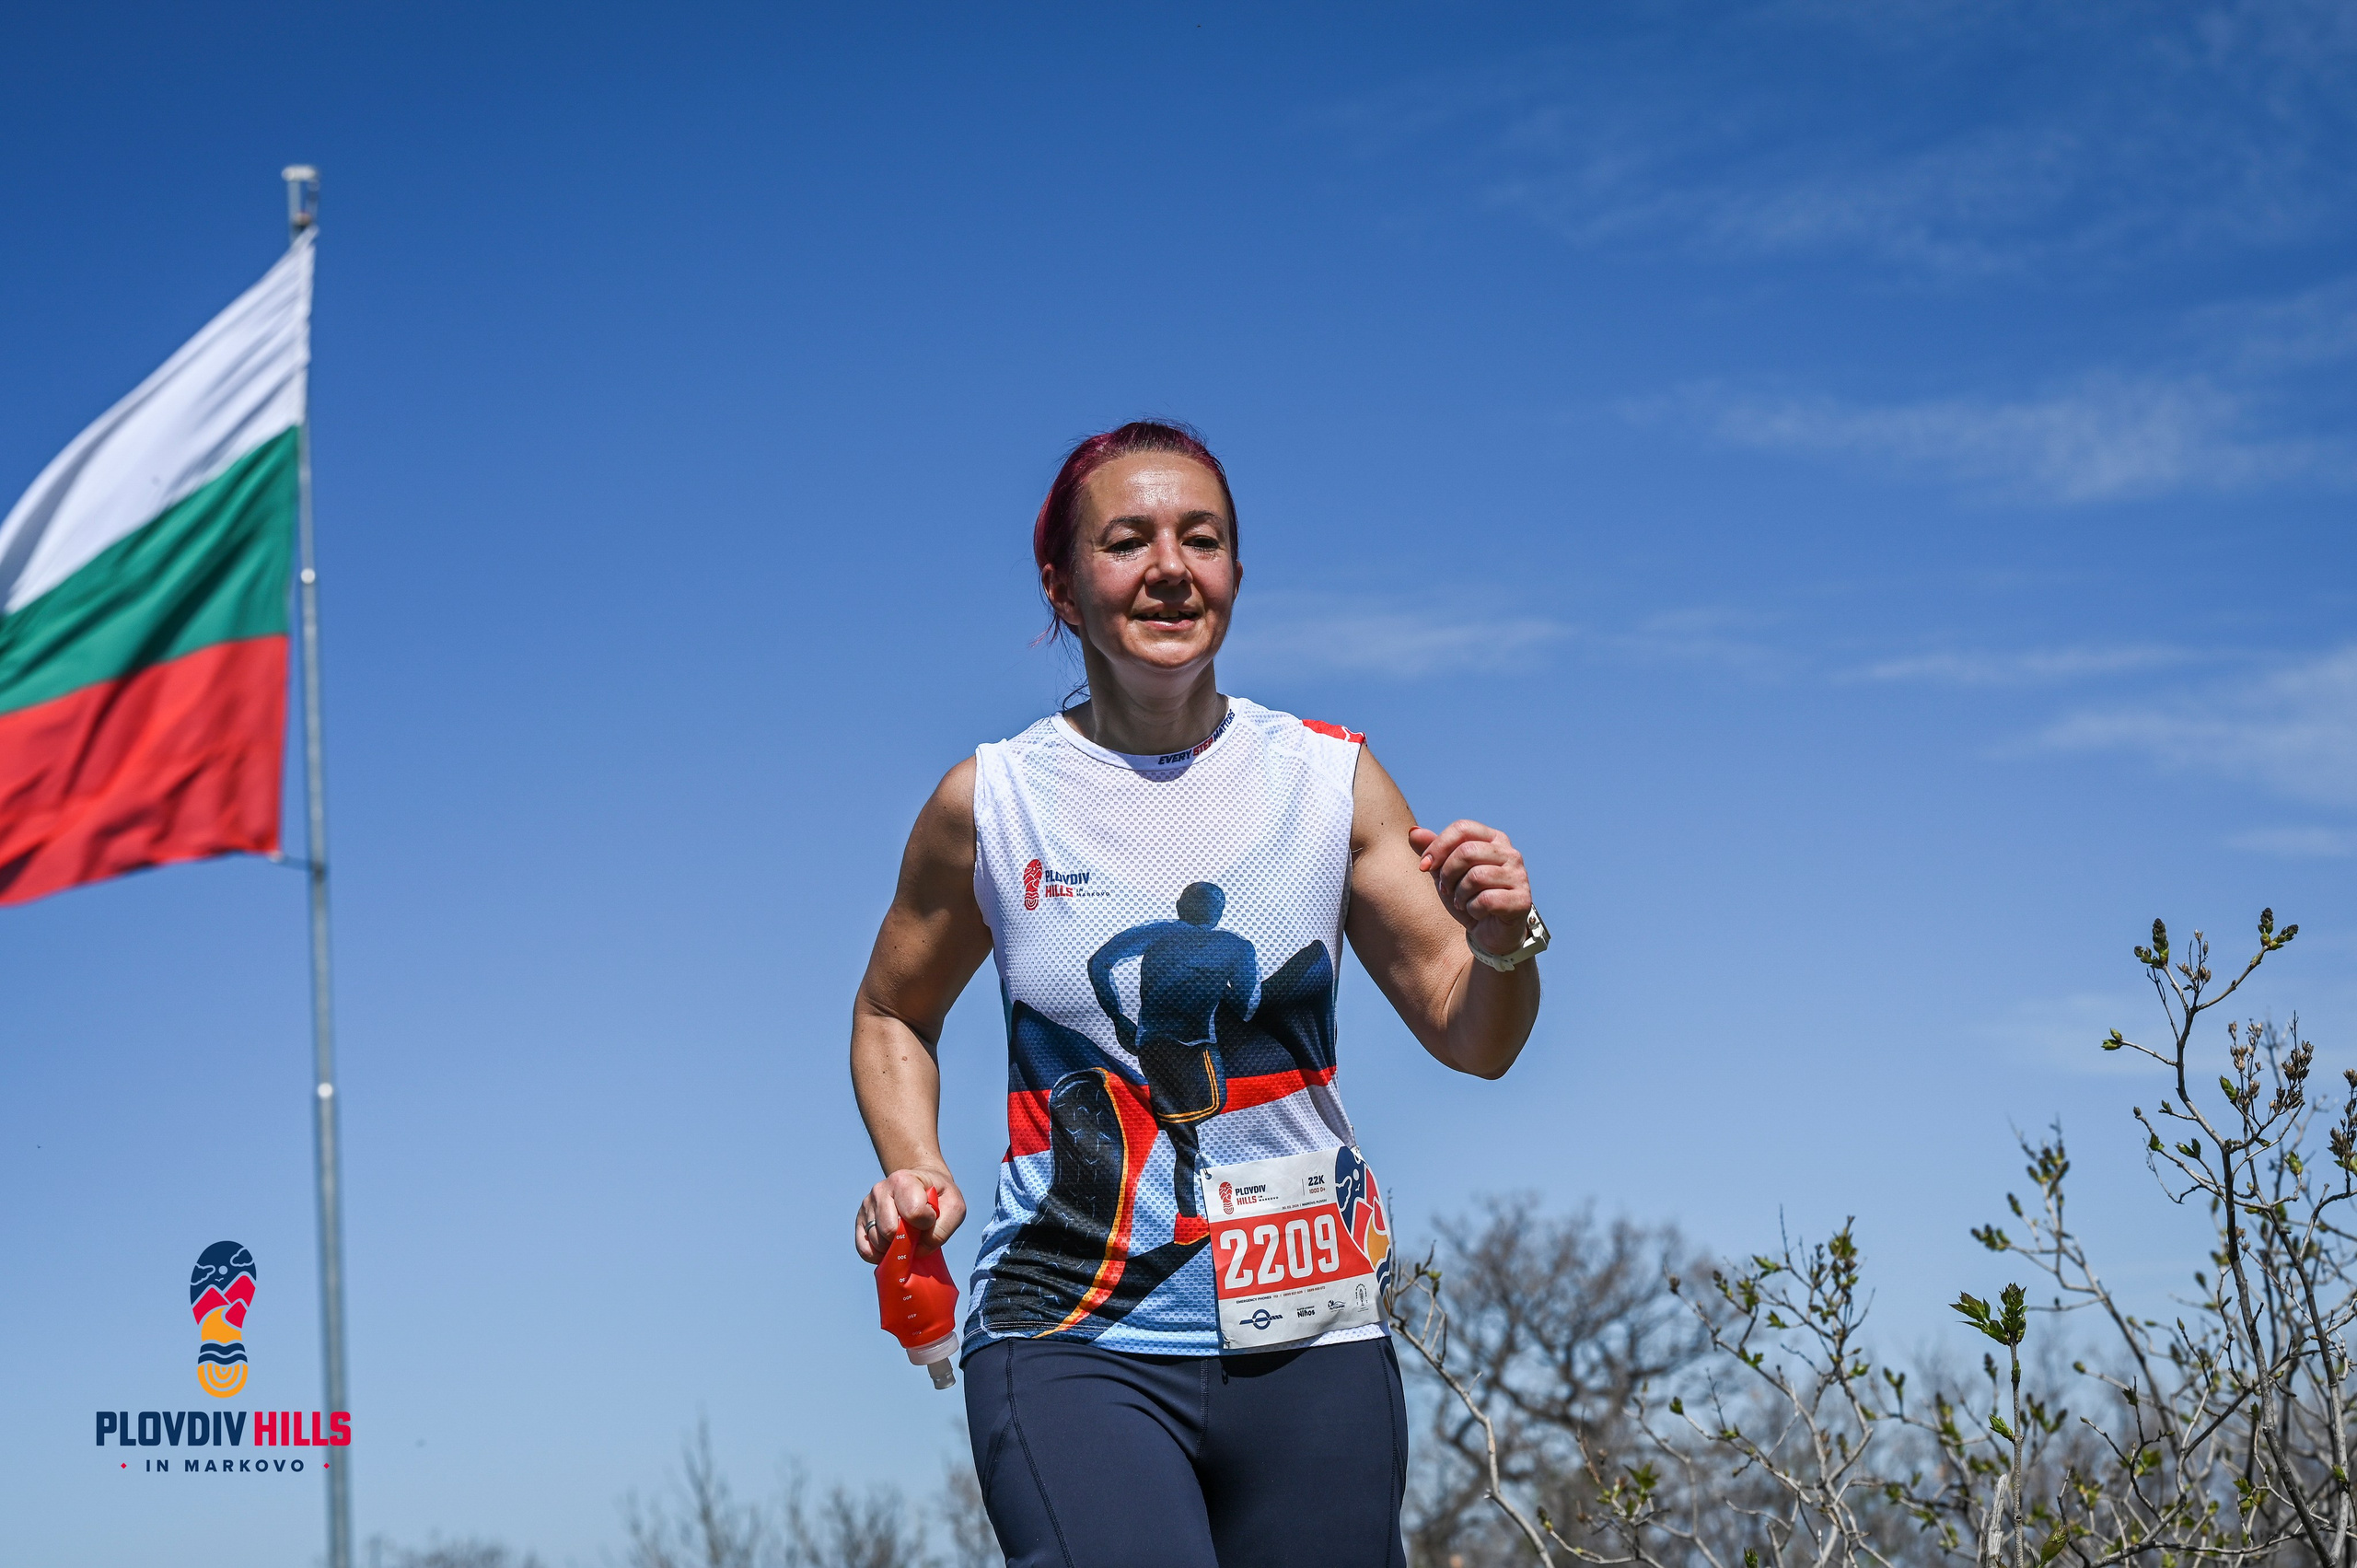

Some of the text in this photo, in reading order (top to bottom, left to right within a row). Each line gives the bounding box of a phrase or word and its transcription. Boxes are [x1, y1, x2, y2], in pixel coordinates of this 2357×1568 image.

[1158, 708, 1236, 765] EVERY STEP MATTERS
[1045, 869, 1090, 886] PLOVDIV
[1045, 885, 1074, 898] HILLS
[1307, 1174, 1325, 1187] 22K
[1235, 1184, 1266, 1197] PLOVDIV
[1237, 1195, 1258, 1206] HILLS
[1219, 1214, 1340, 1290] 2209
[1236, 1296, 1257, 1305] EMERGENCY
